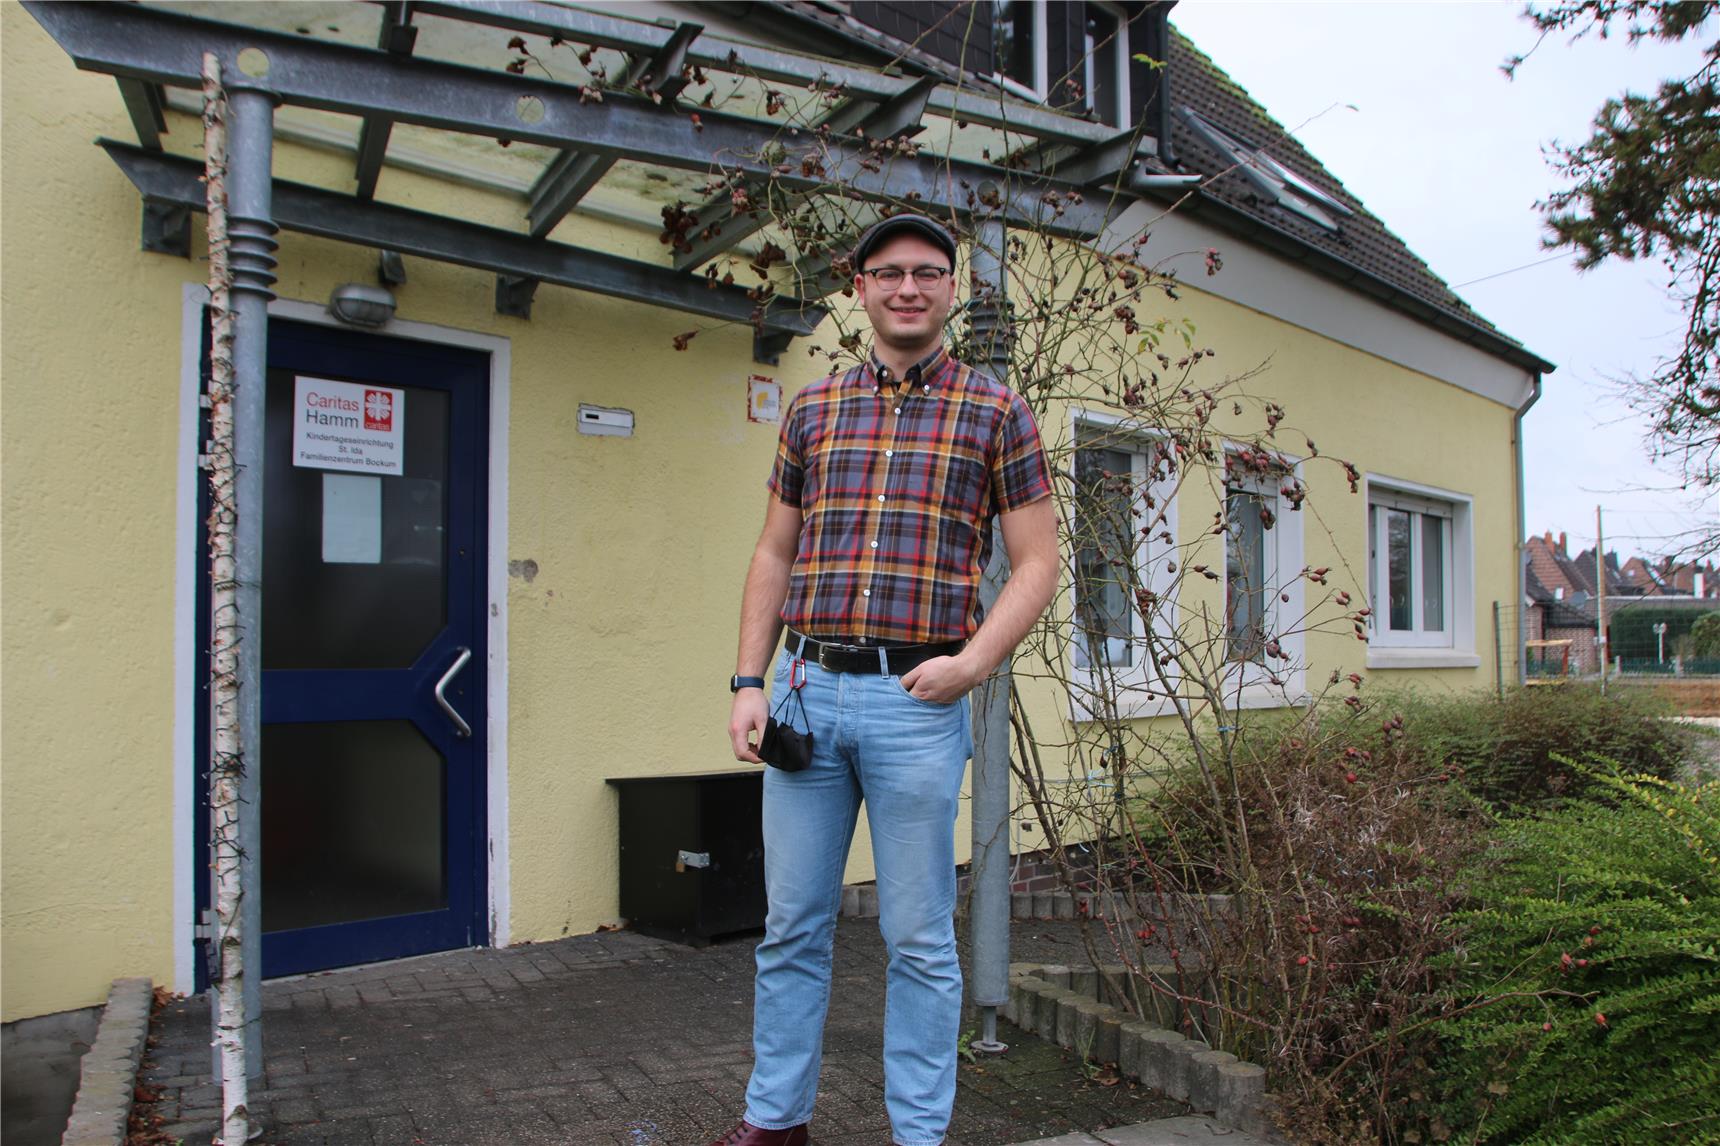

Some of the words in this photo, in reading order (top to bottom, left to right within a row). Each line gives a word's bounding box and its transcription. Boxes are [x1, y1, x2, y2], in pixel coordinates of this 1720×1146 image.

[306, 391, 359, 411] Caritas
[306, 408, 359, 429] Hamm
[306, 432, 394, 449] Kindertageseinrichtung
[338, 445, 348, 453] St.
[300, 451, 364, 464] Familienzentrum
[365, 458, 397, 468] Bockum
